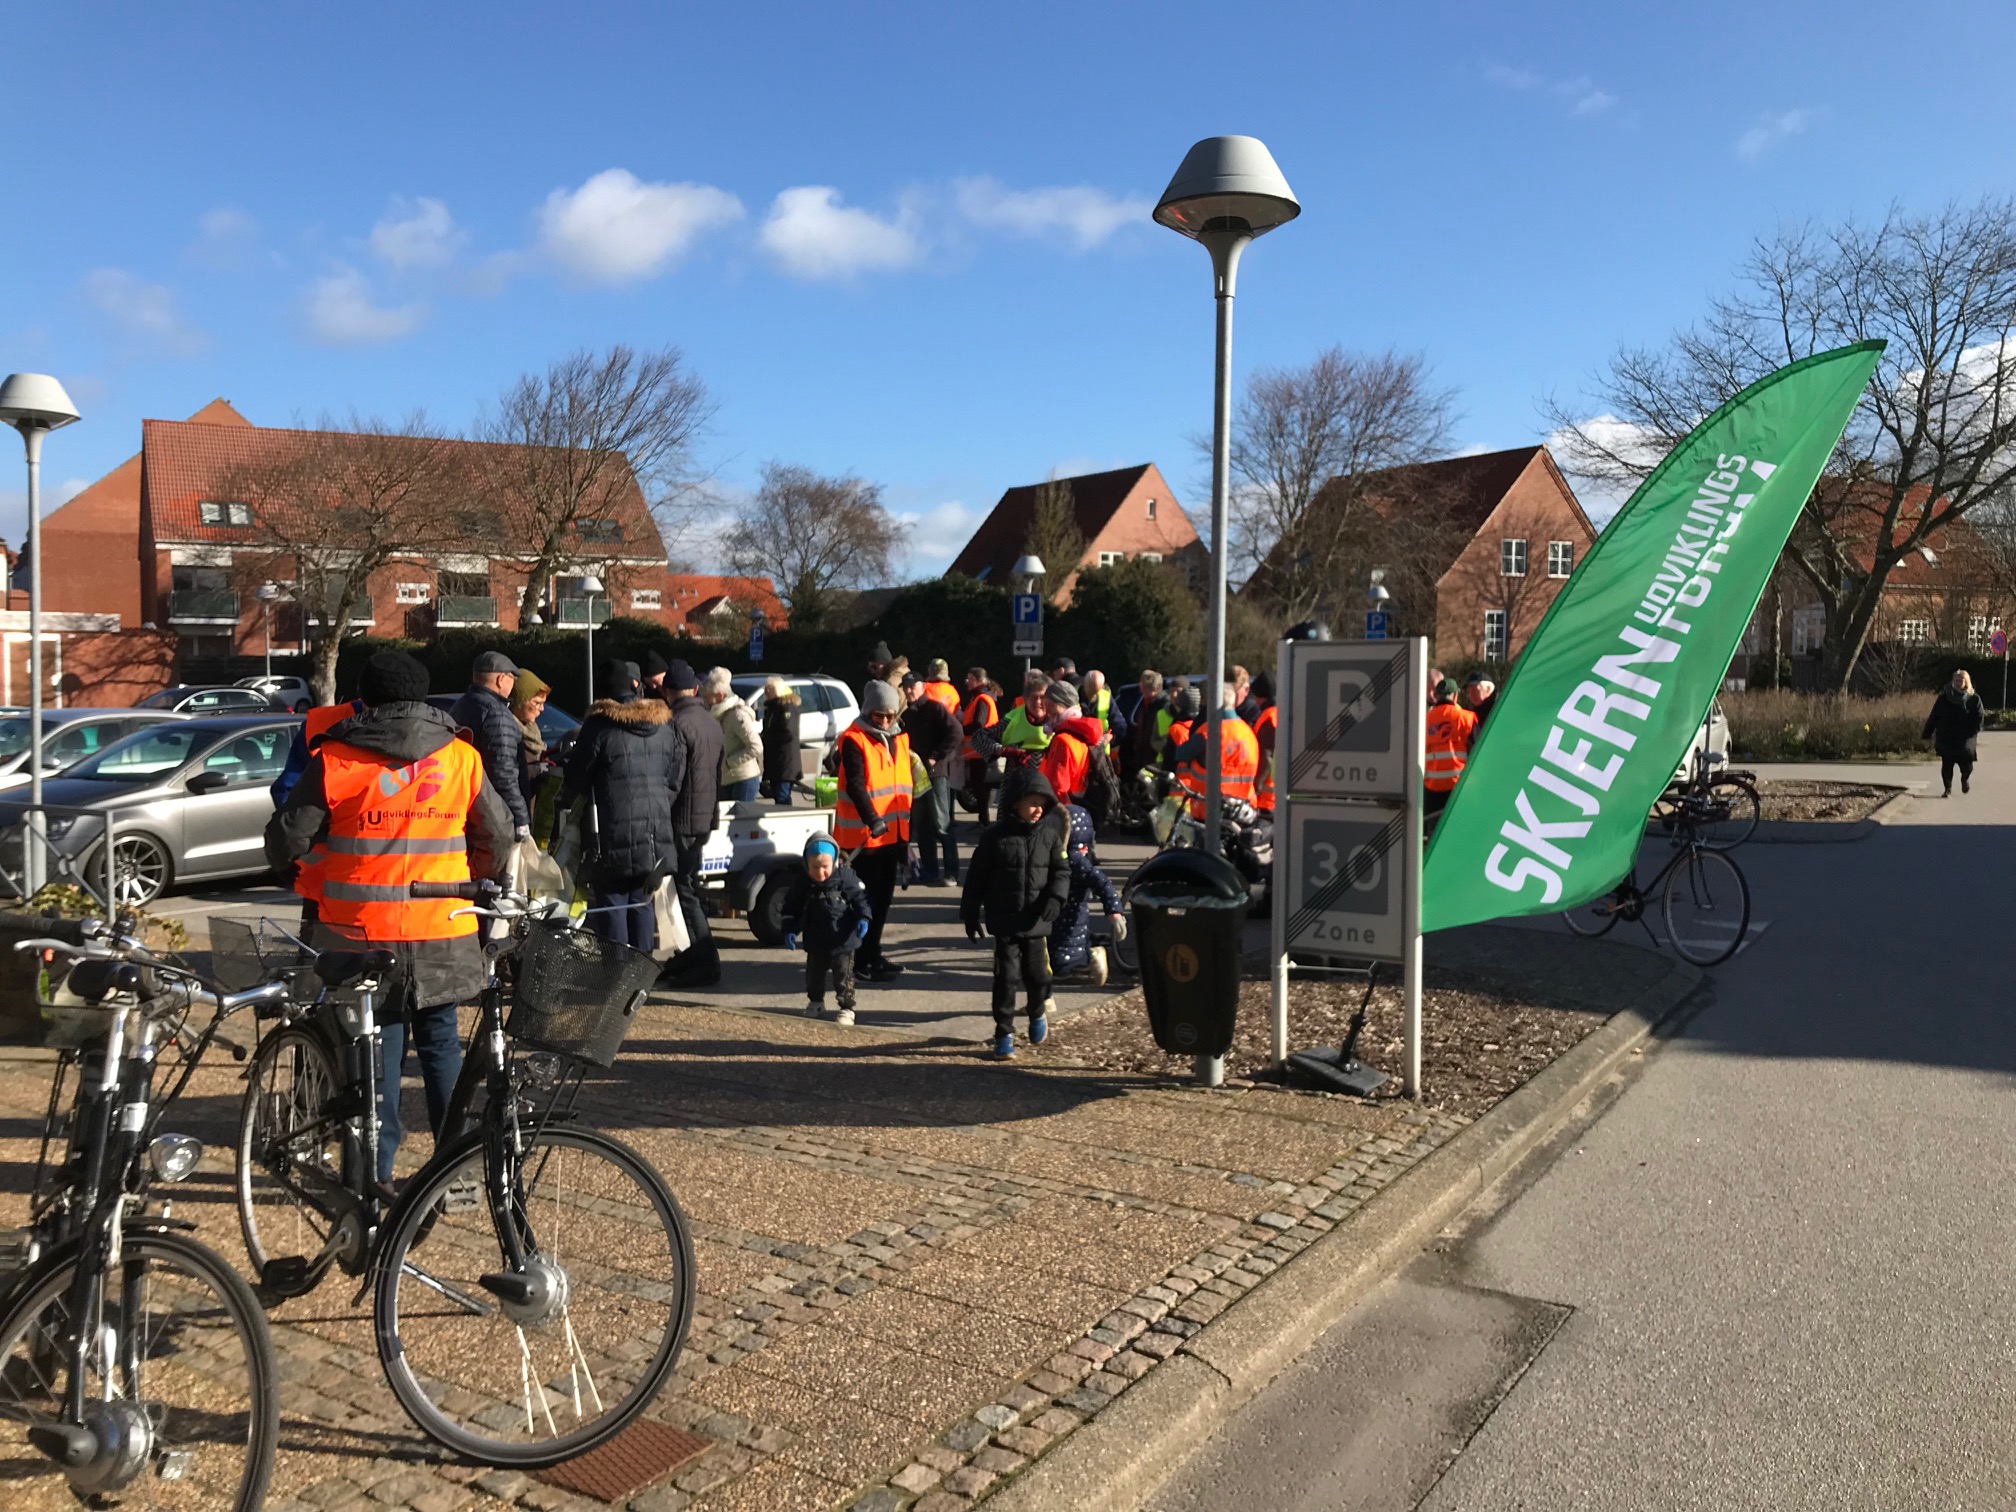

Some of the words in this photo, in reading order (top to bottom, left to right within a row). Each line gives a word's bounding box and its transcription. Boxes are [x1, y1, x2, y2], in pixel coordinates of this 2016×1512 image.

[1634, 453, 1747, 624] UDVIKLINGS
[1020, 597, 1036, 621] P
[1371, 613, 1382, 630] P
[1325, 669, 1376, 742] P
[1315, 761, 1378, 783] Zone
[1484, 625, 1682, 904] SKJERN
[1309, 841, 1382, 893] 30
[1312, 920, 1376, 944] Zone
